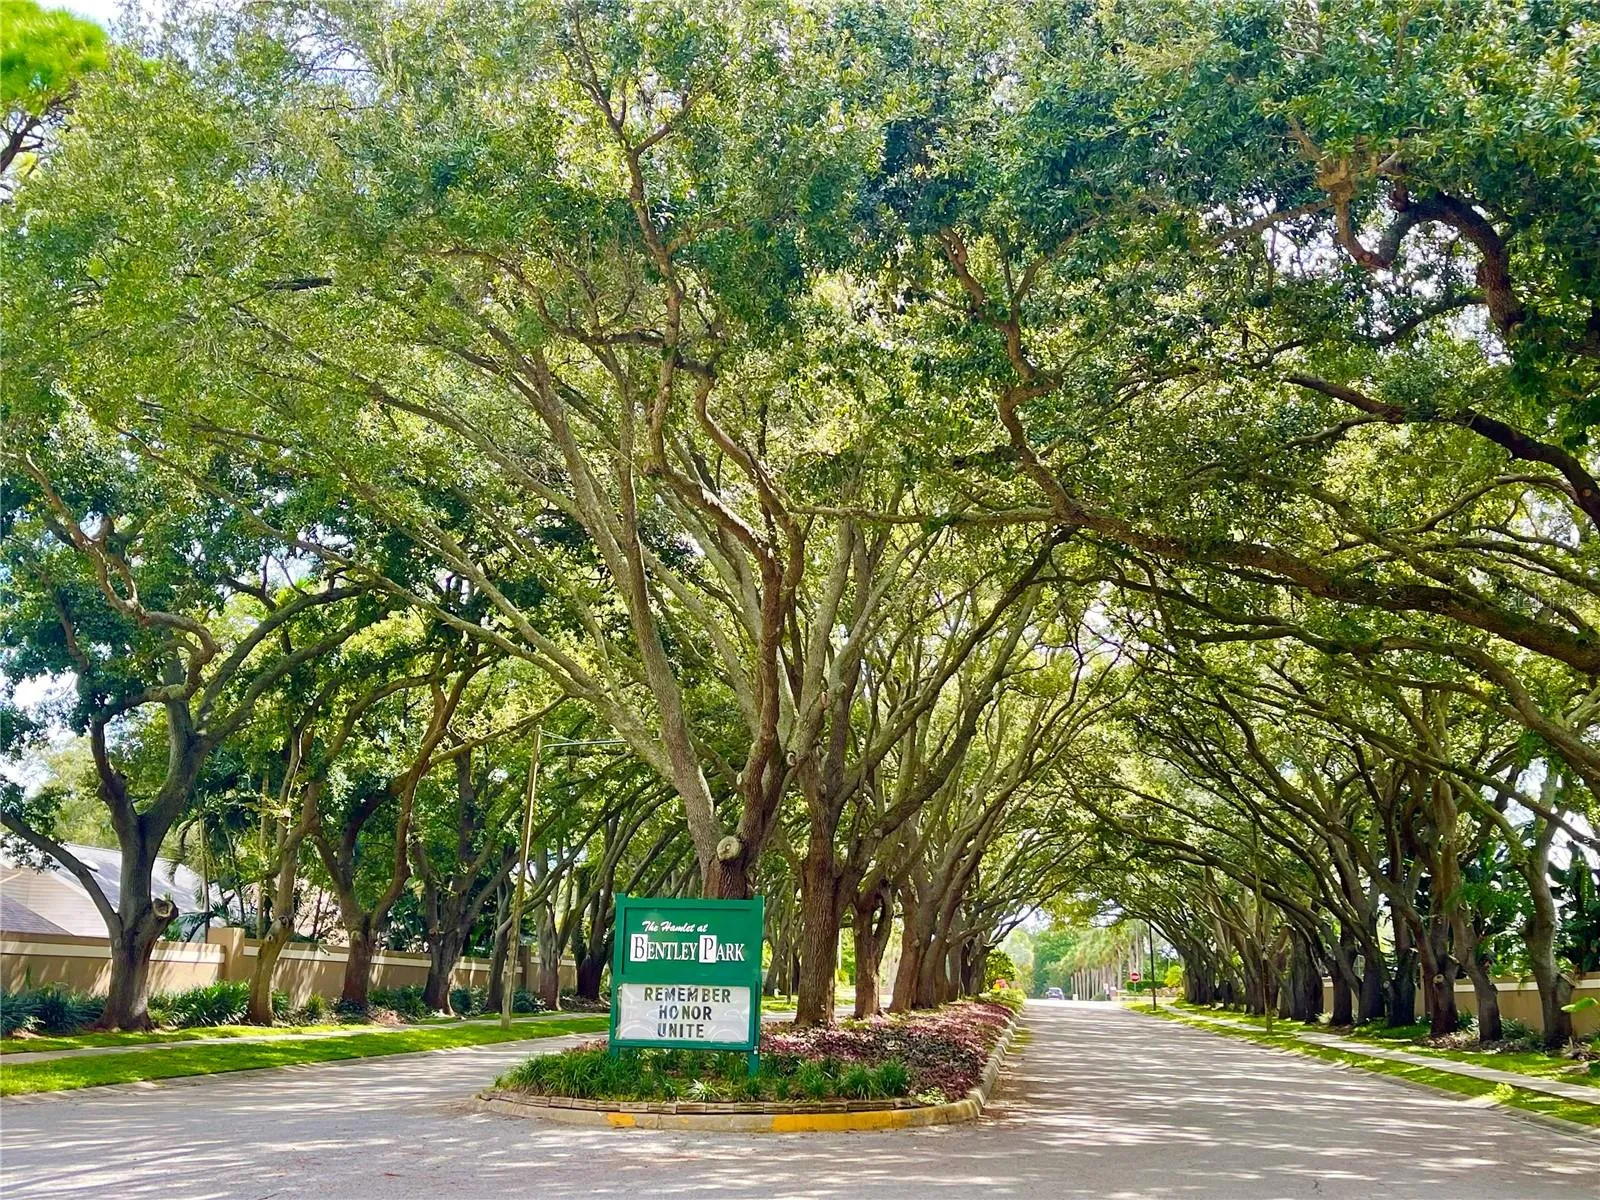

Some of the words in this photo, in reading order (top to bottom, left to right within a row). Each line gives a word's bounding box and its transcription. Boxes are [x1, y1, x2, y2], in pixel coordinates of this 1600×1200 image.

[642, 921, 659, 932] The
[661, 921, 696, 932] Hamlet
[697, 923, 708, 932] at
[644, 986, 731, 1003] REMEMBER
[659, 1004, 713, 1021] HONOR
[657, 1022, 705, 1039] UNITE
